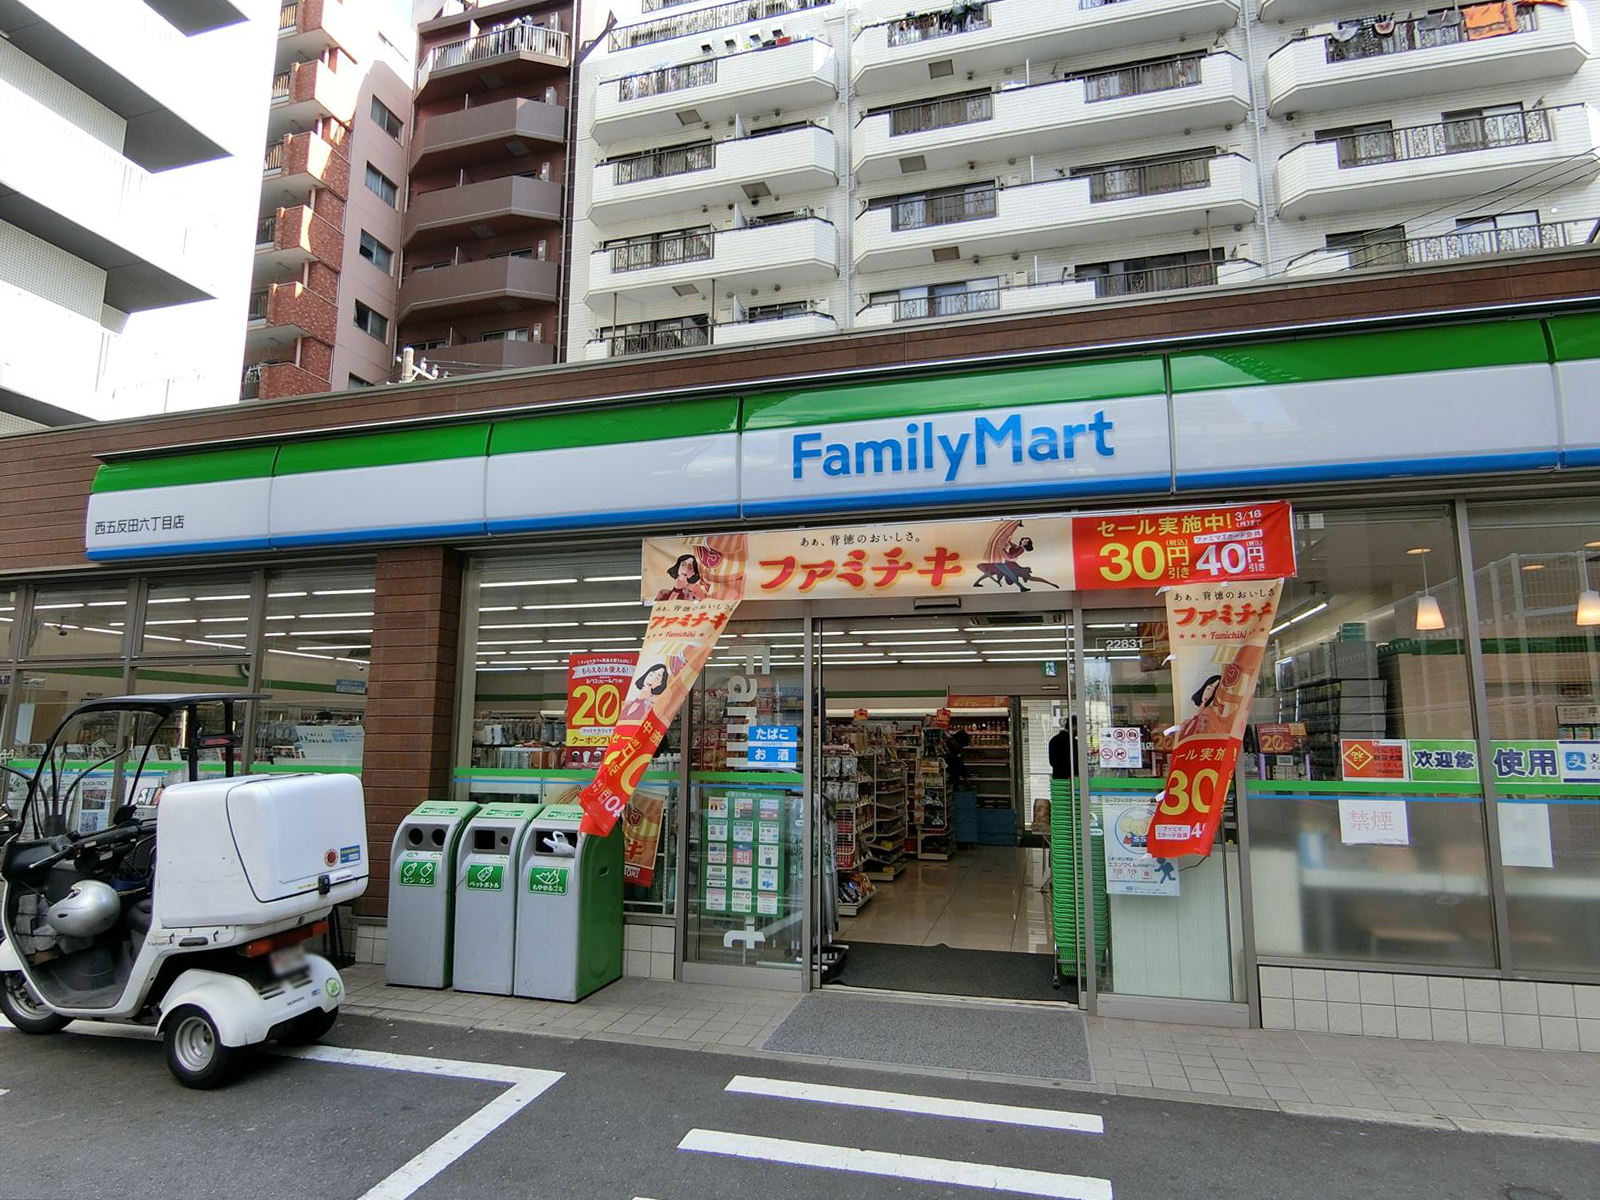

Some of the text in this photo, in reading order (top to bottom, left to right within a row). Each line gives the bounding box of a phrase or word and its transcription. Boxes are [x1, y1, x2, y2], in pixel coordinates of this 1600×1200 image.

[792, 409, 1115, 482] FamilyMart
[94, 515, 185, 535] 西五反田六丁目店
[1234, 509, 1262, 521] 3/18
[758, 546, 964, 592] ファミチキ
[1099, 540, 1166, 582] 30
[1195, 543, 1246, 576] 40
[1105, 640, 1143, 649] 22831
[755, 727, 789, 740] たばこ
[1414, 750, 1475, 769] 欢迎您
[1493, 749, 1559, 777] 使用
